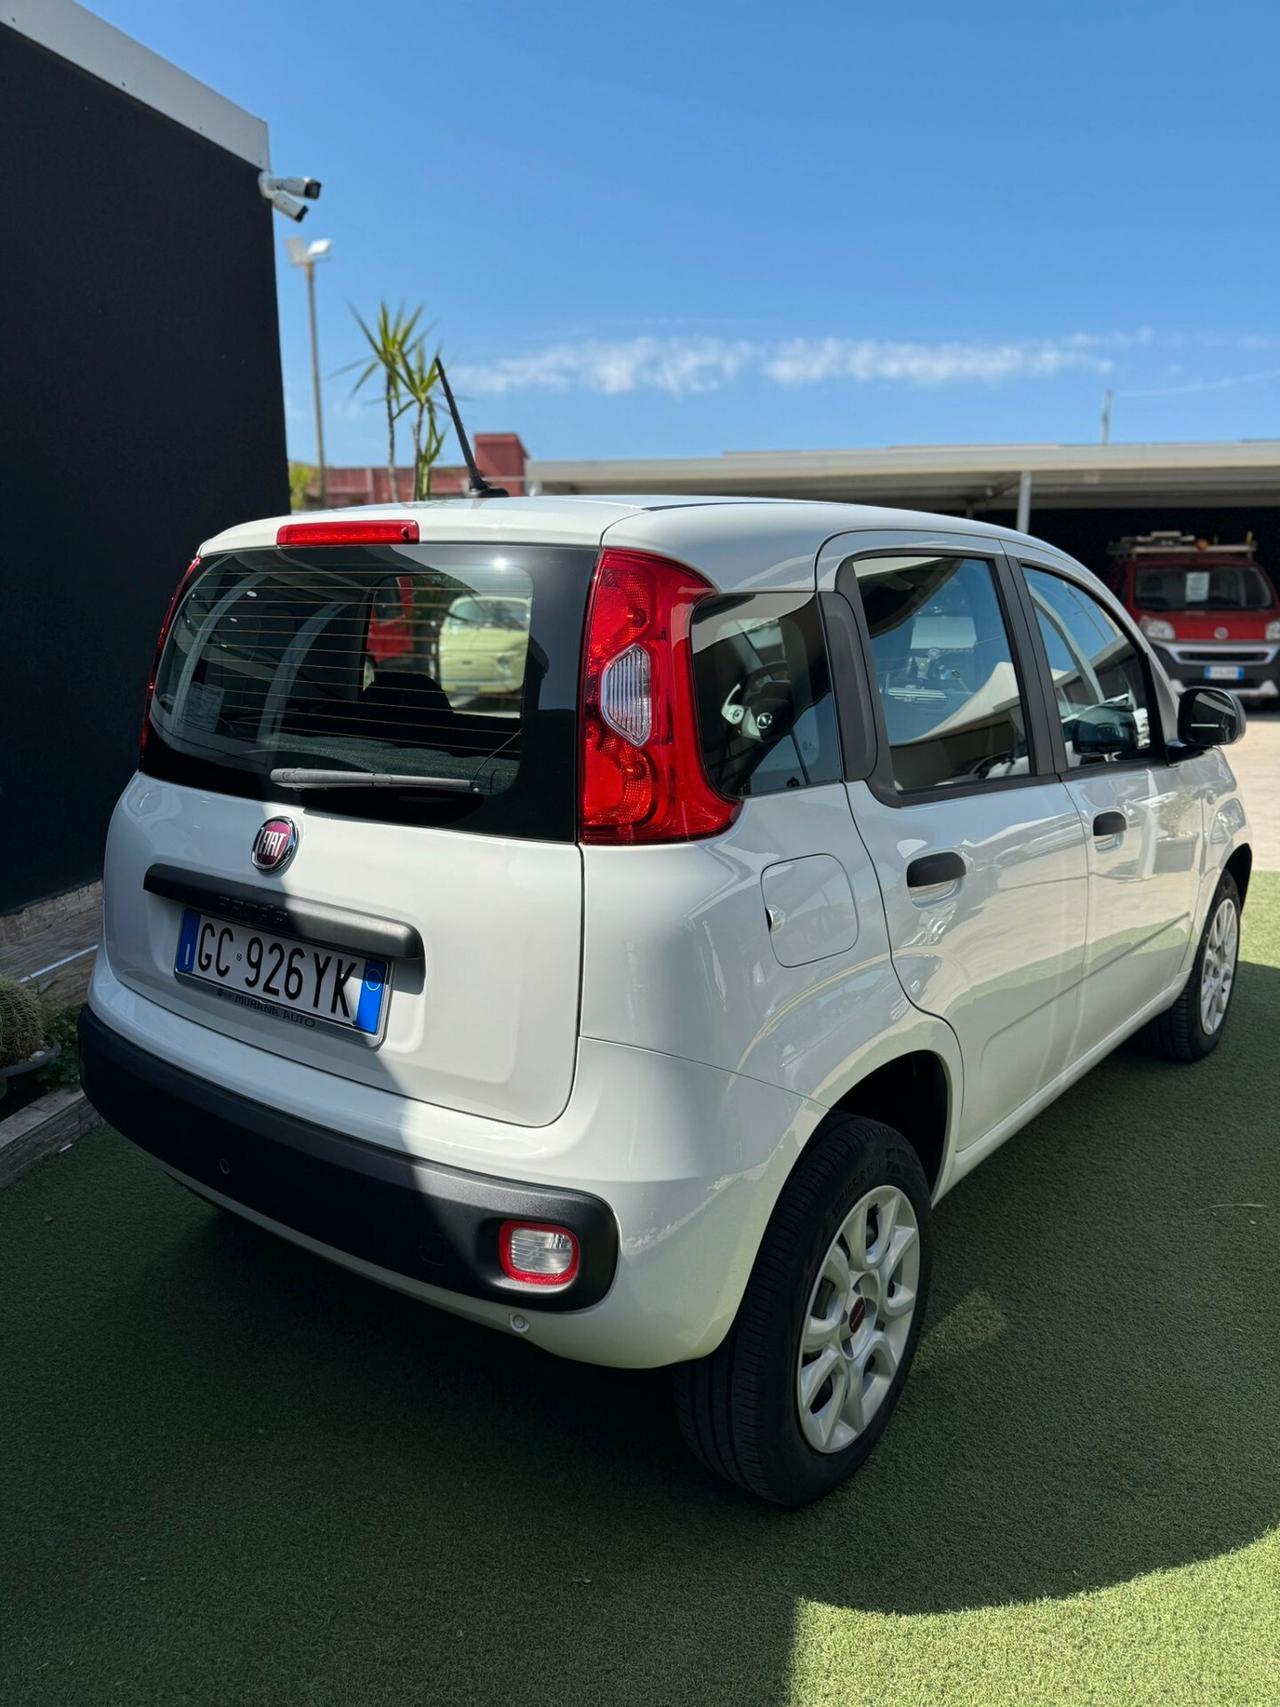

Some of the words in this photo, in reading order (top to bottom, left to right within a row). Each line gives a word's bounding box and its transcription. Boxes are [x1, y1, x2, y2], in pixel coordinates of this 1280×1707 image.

[259, 831, 287, 857] FIAT
[198, 922, 234, 977] GC
[283, 1011, 316, 1028] AUTO
